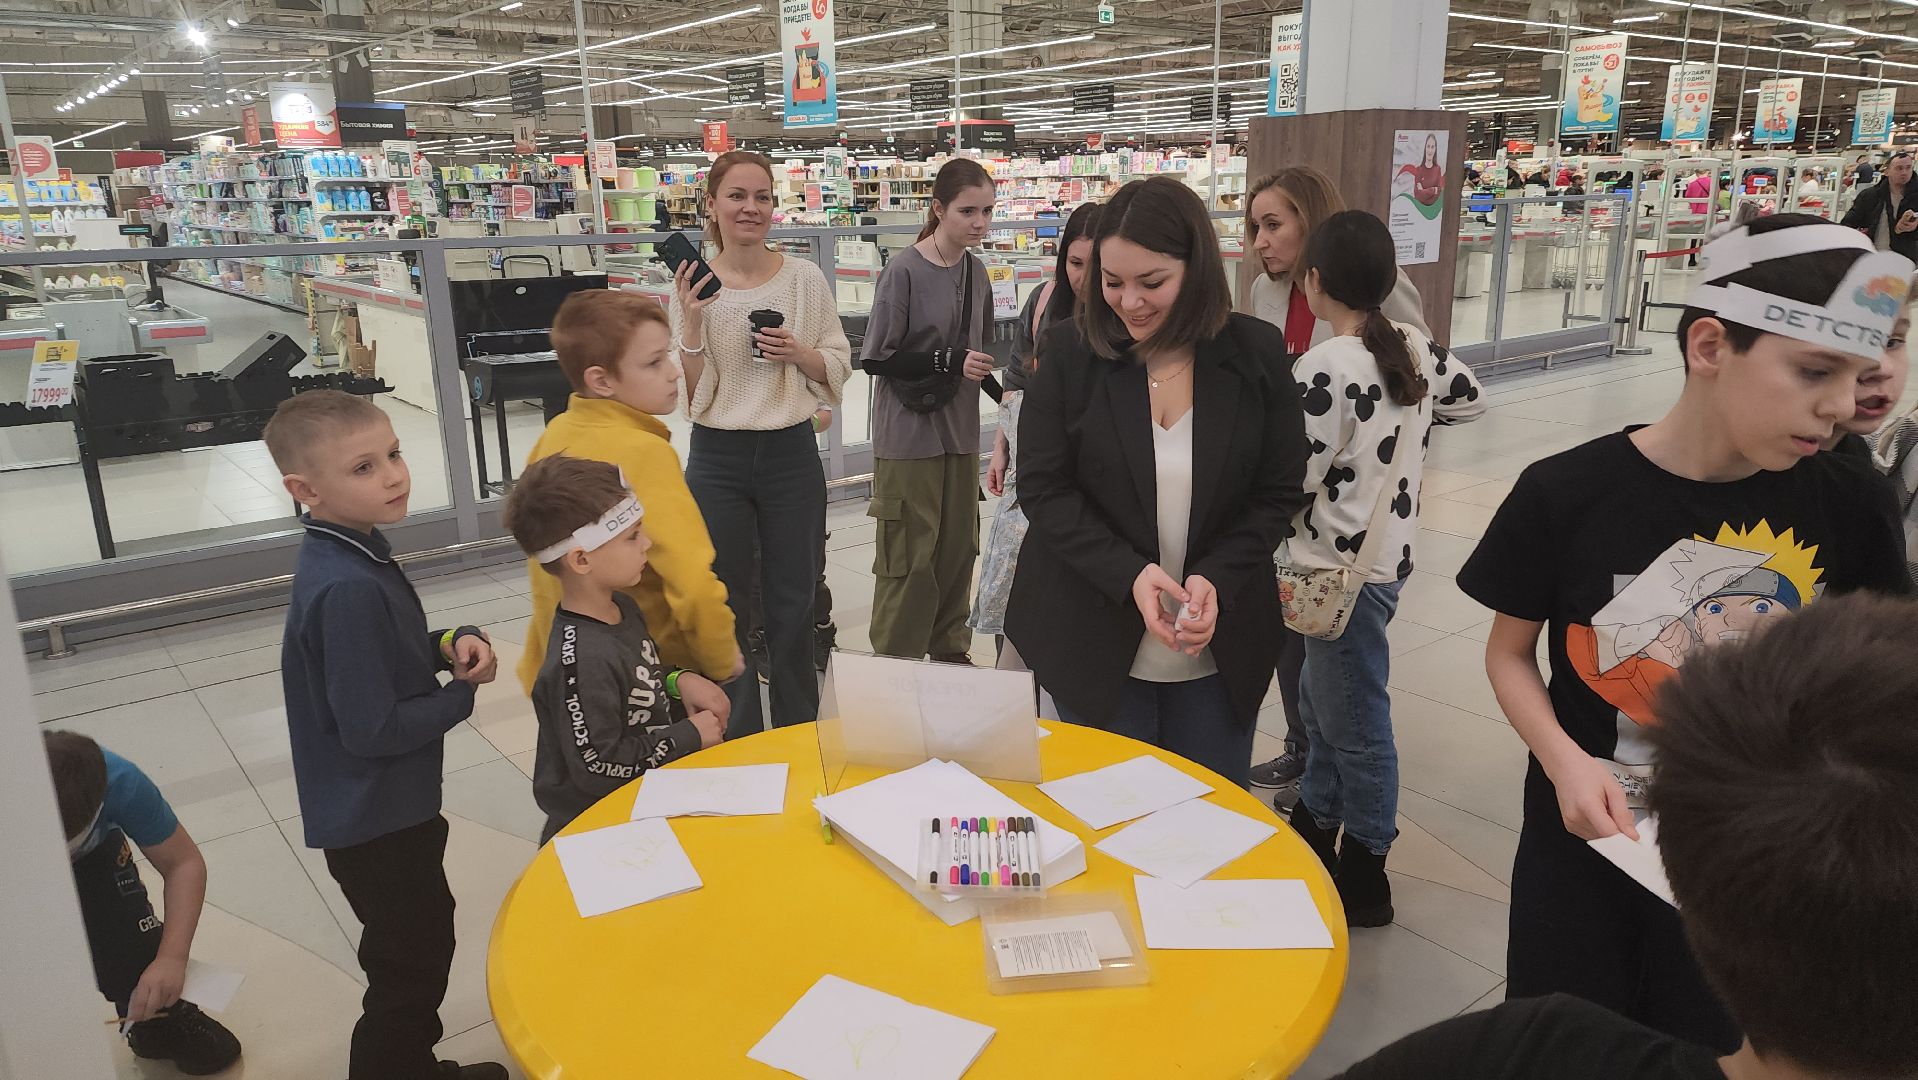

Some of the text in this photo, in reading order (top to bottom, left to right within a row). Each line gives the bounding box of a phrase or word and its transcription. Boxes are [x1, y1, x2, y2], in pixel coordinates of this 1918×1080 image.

[341, 121, 371, 130] Бытовая
[566, 693, 590, 747] SCHOOL
[582, 747, 599, 764] IN
